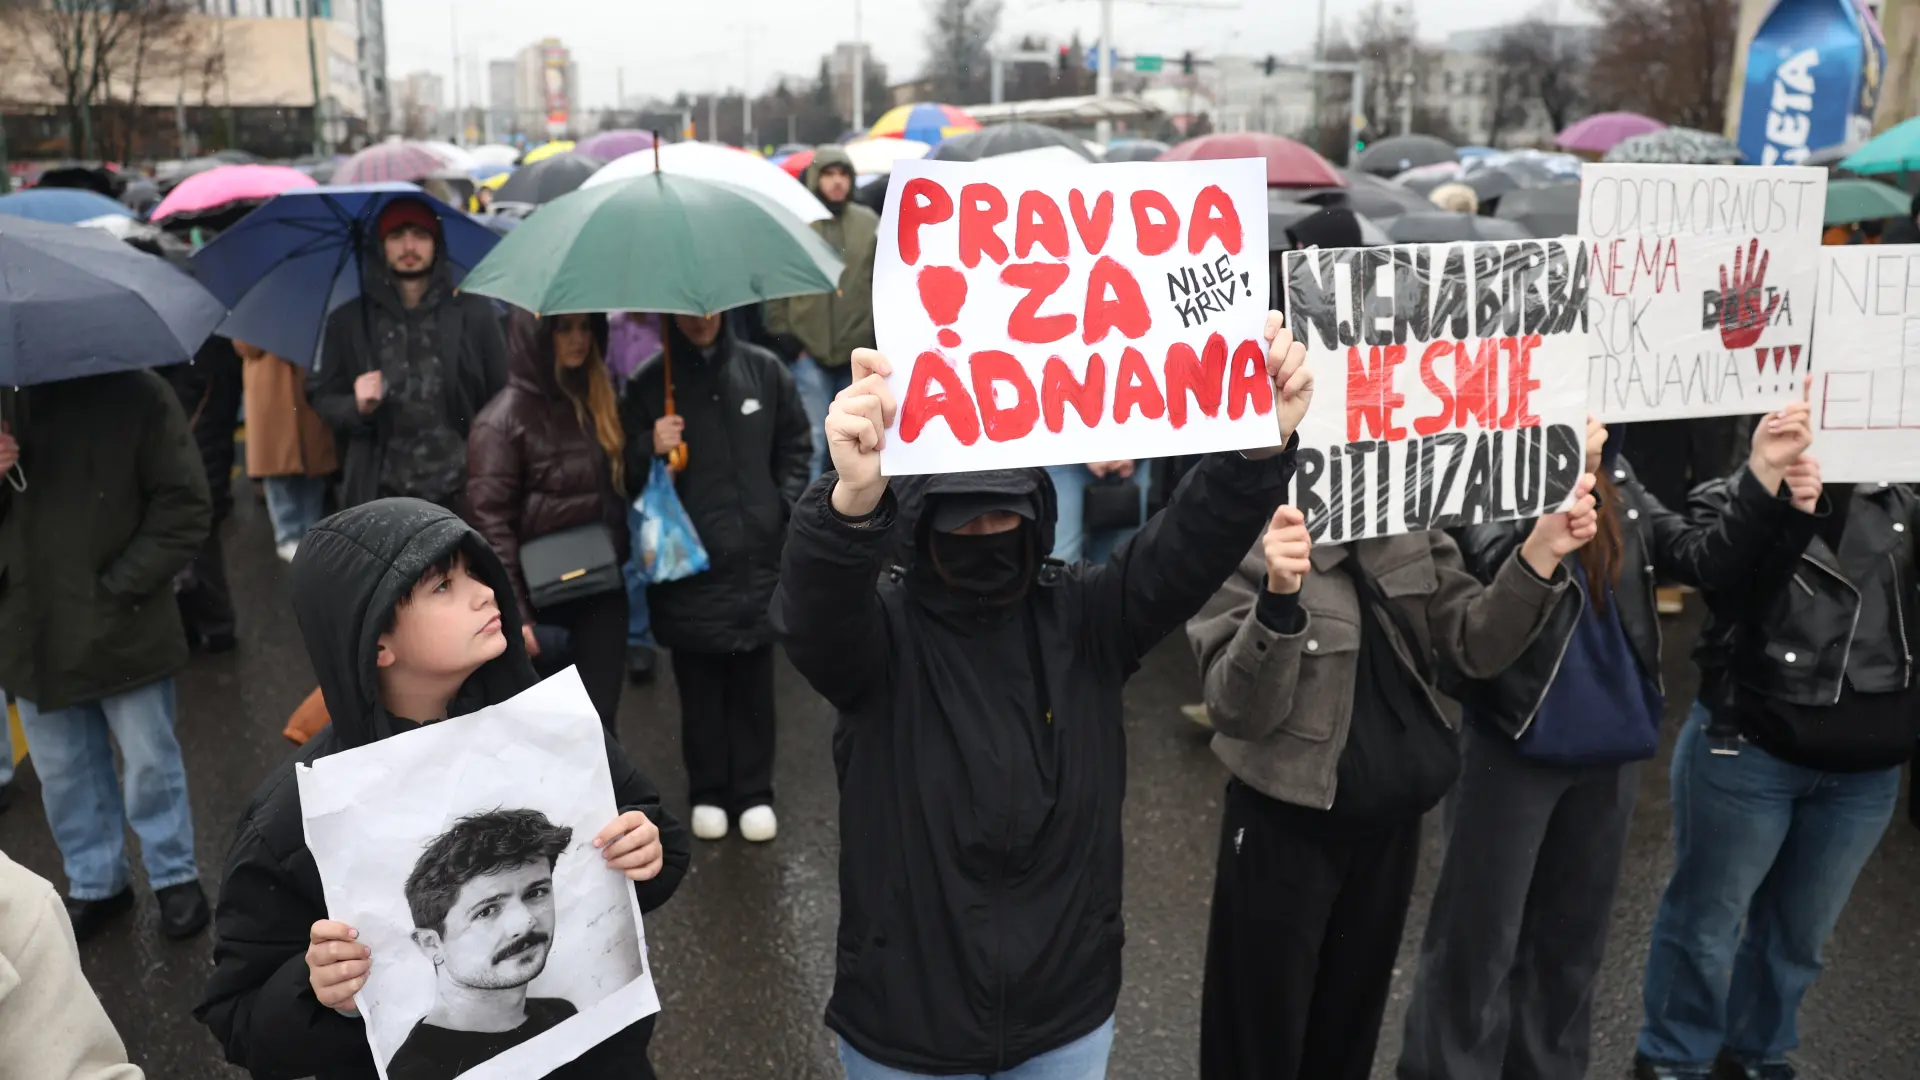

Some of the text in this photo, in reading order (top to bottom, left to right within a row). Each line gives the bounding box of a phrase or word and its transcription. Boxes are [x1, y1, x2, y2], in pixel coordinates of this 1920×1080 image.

[898, 178, 1243, 268] PRAVDA
[1589, 176, 1816, 238] ODGOVORNOST
[999, 256, 1152, 345] ZA
[1167, 254, 1234, 302] NIJE
[1589, 236, 1680, 296] NEMA
[1588, 297, 1652, 355] ROK
[899, 331, 1273, 446] ADNANA
[1346, 334, 1542, 442] NE SMIJE
[1296, 424, 1580, 545] BITI UZALUD
